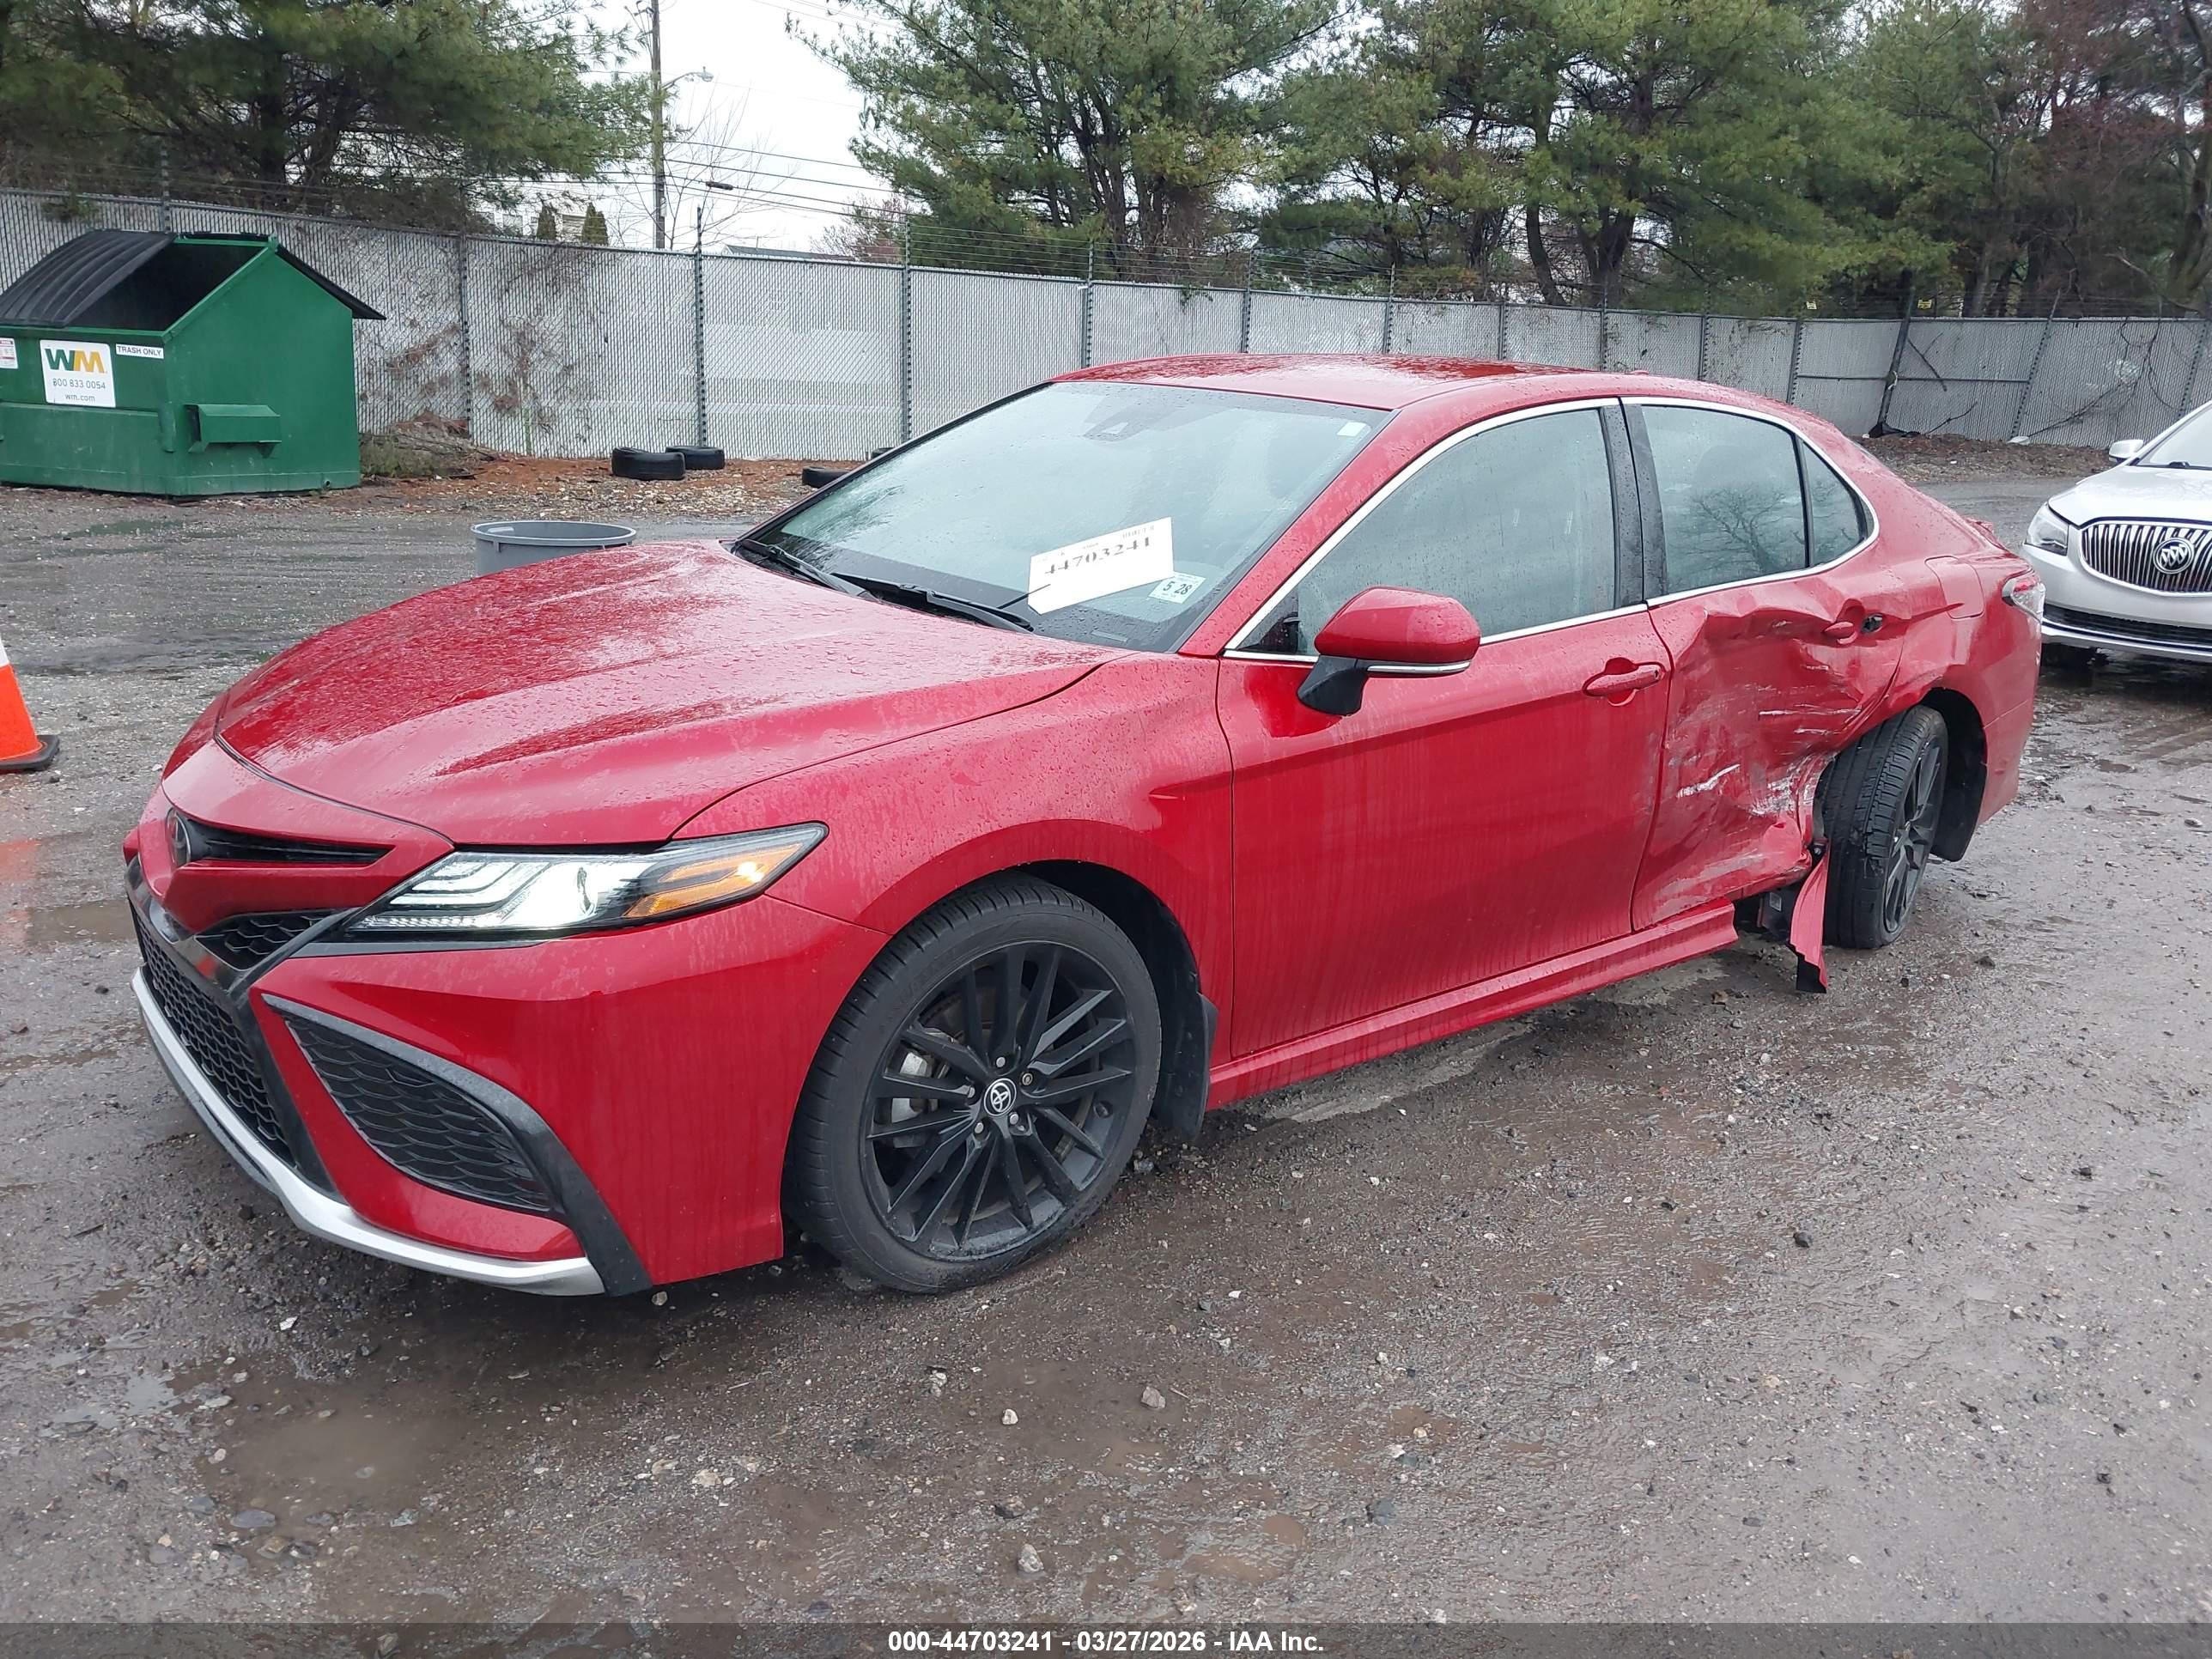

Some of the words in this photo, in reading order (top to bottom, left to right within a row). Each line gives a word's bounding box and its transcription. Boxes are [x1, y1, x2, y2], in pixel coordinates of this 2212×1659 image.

[117, 345, 142, 355] TRASH
[143, 348, 161, 356] ONLY
[45, 348, 106, 374] WM
[52, 378, 68, 387] 800
[70, 379, 84, 388] 833
[86, 380, 106, 390] 0054
[65, 393, 95, 402] wm.com
[1163, 580, 1176, 592] 5
[1174, 583, 1193, 595] 28
